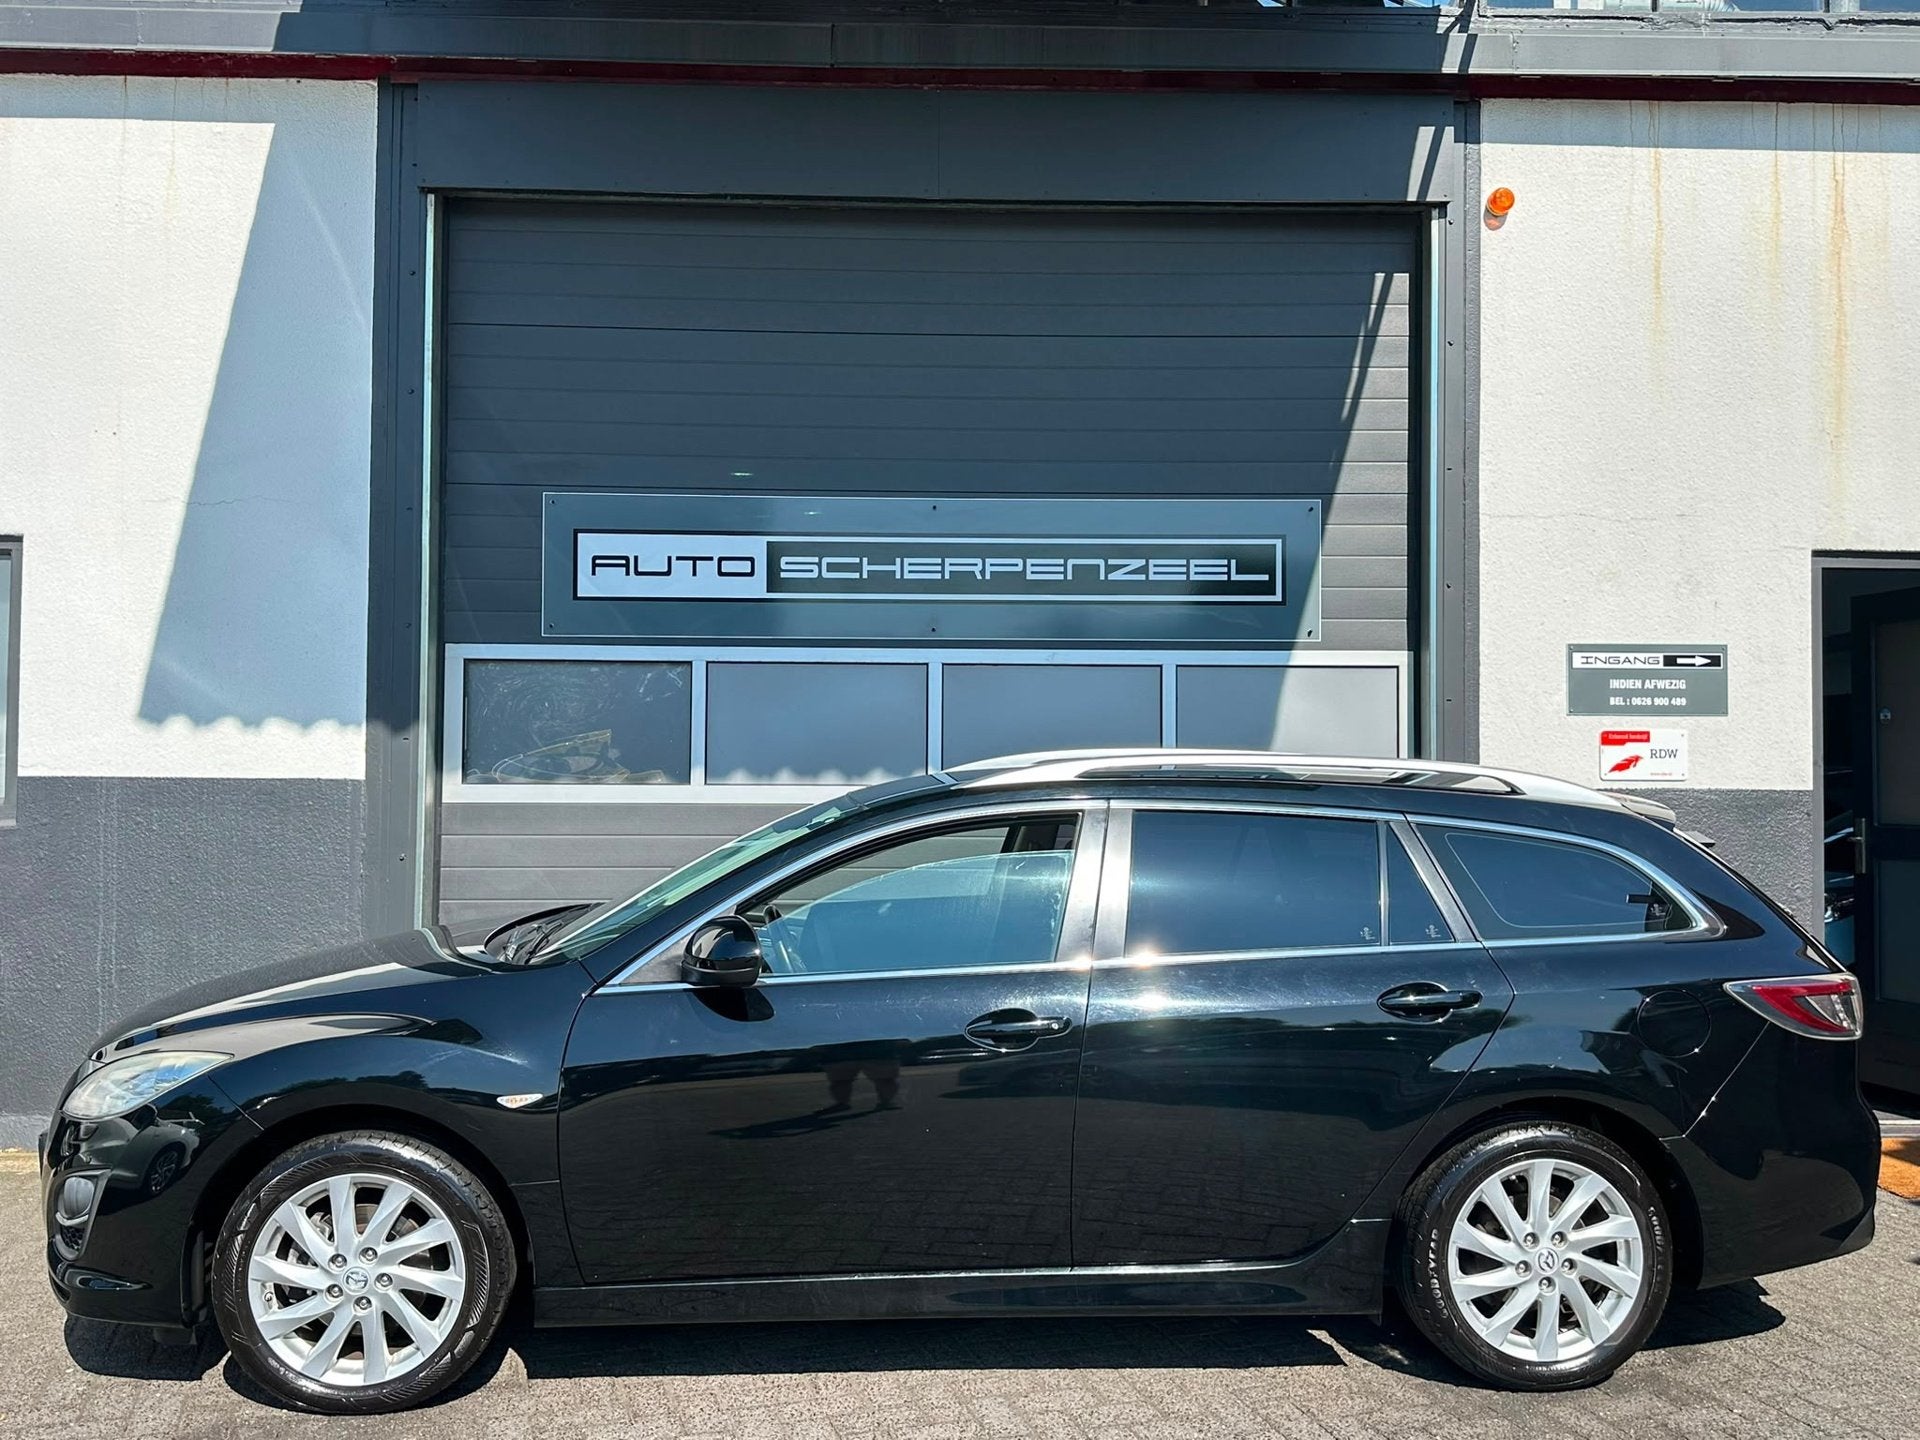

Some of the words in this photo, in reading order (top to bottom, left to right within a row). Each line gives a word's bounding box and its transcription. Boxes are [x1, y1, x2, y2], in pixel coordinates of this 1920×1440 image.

[591, 555, 756, 577] AUTO
[779, 556, 1270, 581] SCHERPENZEEL
[1580, 655, 1660, 665] INGANG
[1609, 679, 1642, 690] INDIEN
[1643, 679, 1686, 690] AFWEZIG
[1609, 697, 1625, 706] BEL
[1653, 697, 1669, 706] 900
[1670, 697, 1687, 706] 489
[1649, 749, 1678, 759] RDW
